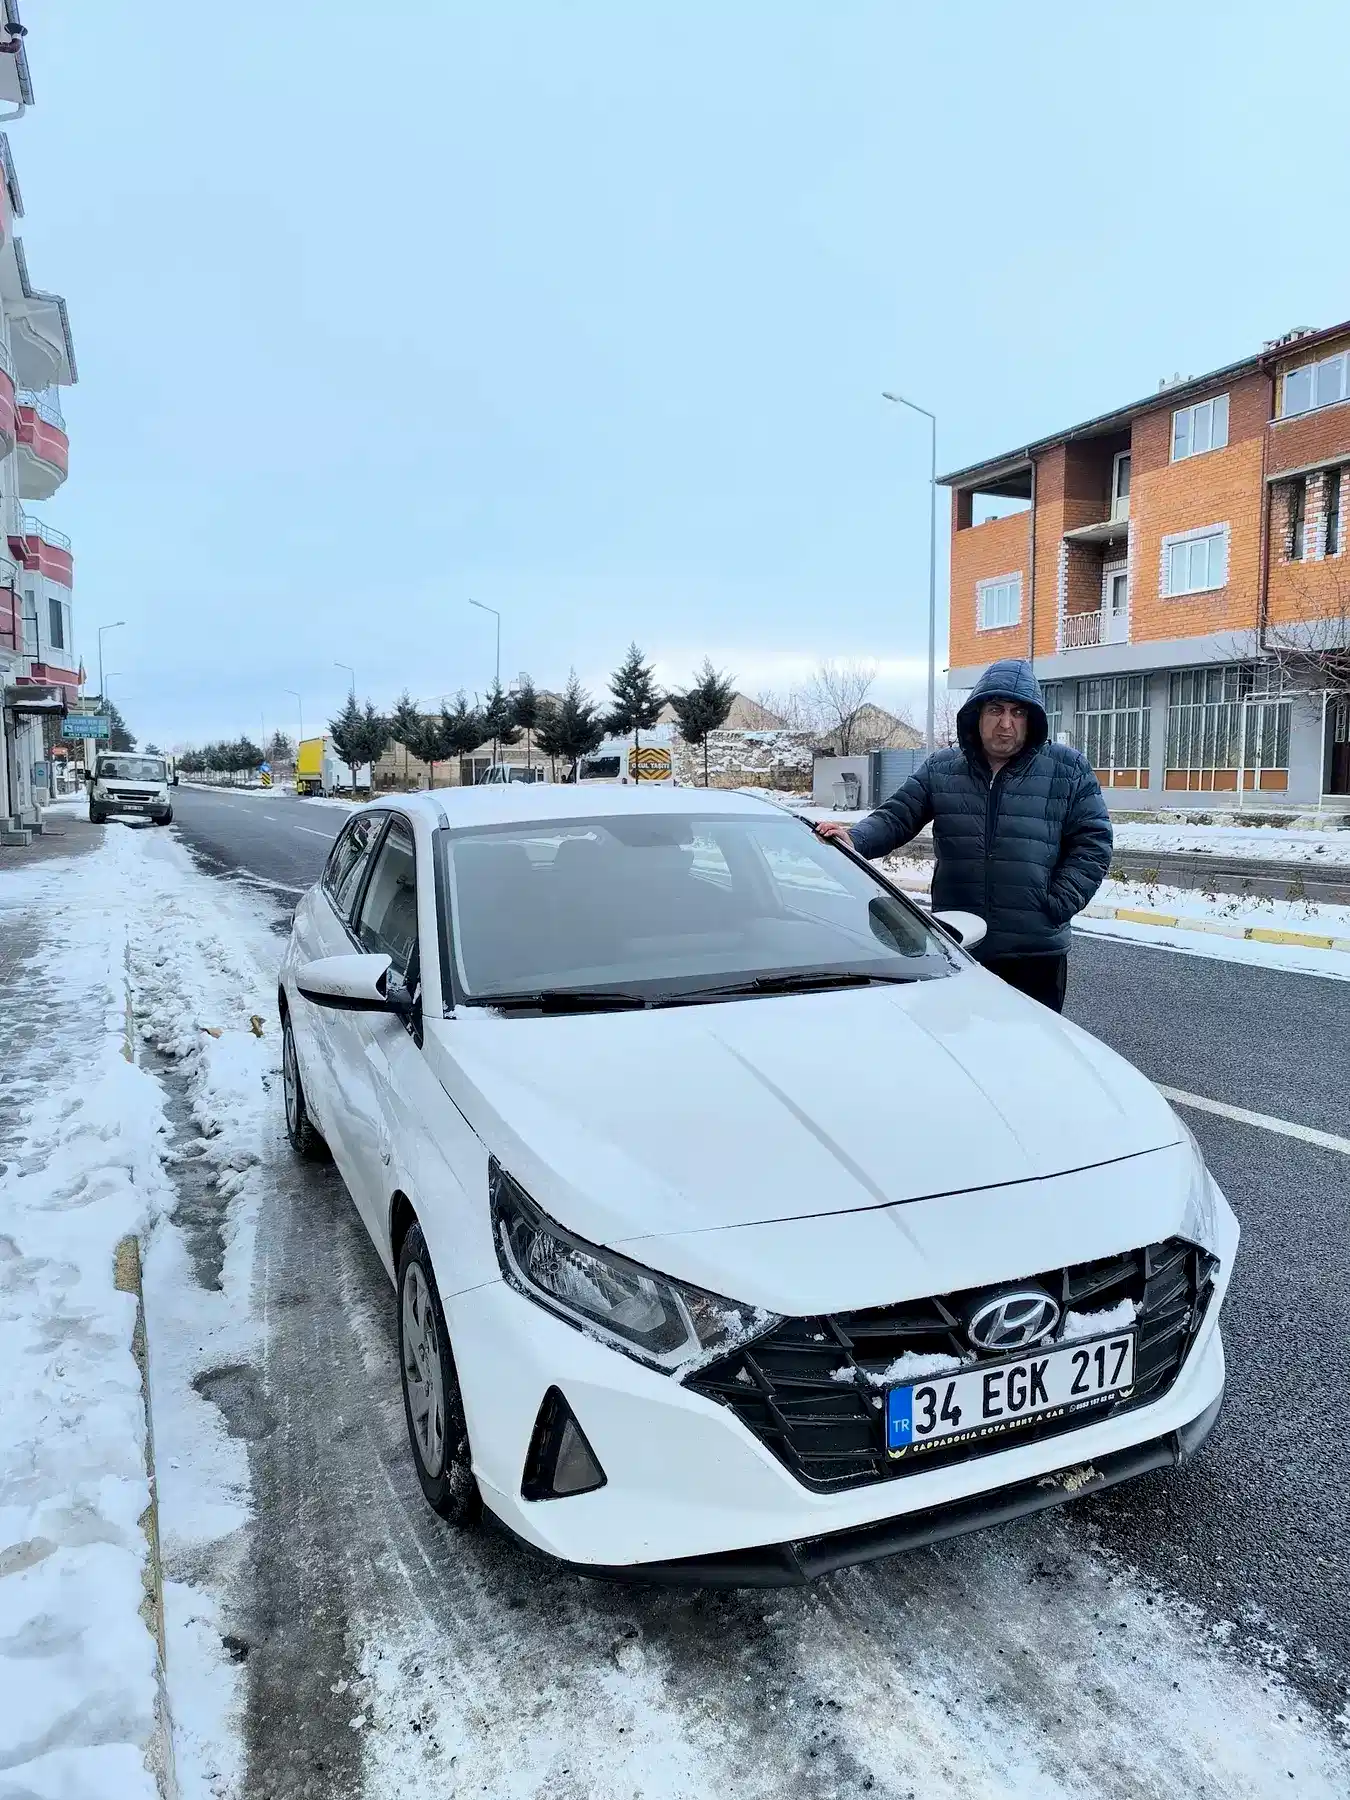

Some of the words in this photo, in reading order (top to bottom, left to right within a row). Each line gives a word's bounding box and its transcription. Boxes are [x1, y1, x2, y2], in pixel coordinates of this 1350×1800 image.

[915, 1381, 962, 1434] 34
[982, 1359, 1050, 1419] EGK
[1070, 1339, 1129, 1395] 217
[893, 1419, 910, 1432] TR
[913, 1432, 977, 1452] CAPPADOCIA
[981, 1424, 1005, 1435] ROYA
[1009, 1417, 1033, 1428] RENT
[1046, 1408, 1065, 1419] CAR
